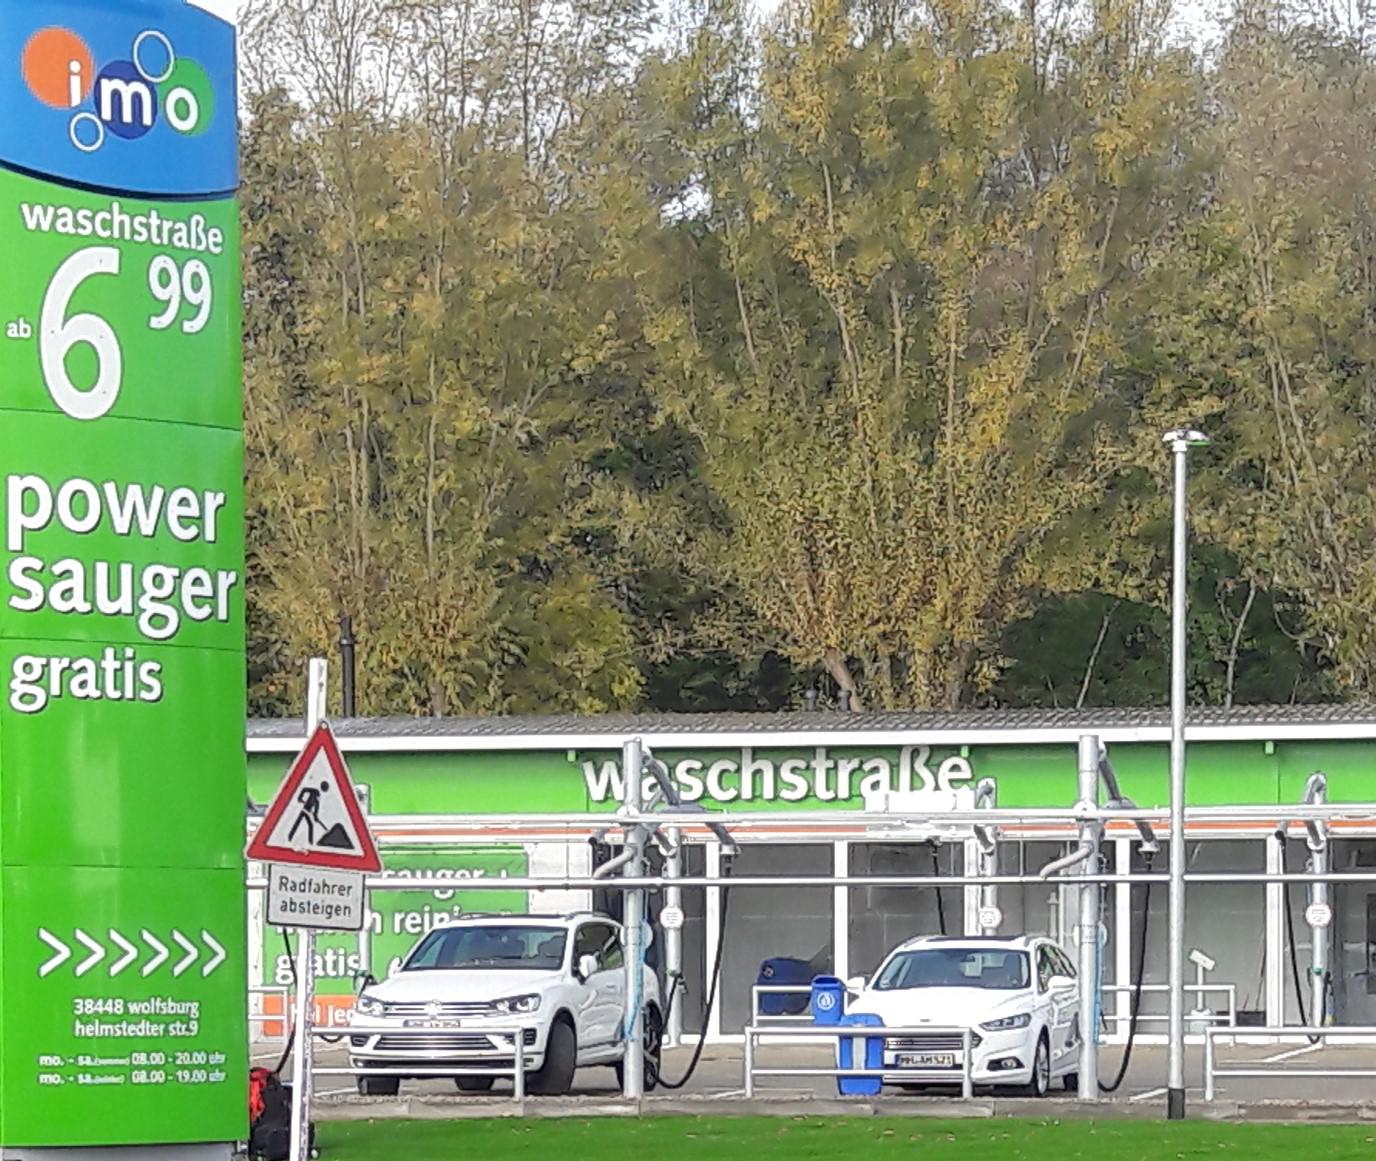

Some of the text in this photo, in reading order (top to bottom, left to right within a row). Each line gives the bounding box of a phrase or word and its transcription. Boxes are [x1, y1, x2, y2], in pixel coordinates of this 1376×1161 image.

[69, 60, 199, 132] imo
[21, 202, 224, 255] waschstraße
[6, 246, 213, 420] ab 6 99
[7, 473, 226, 552] power
[8, 556, 237, 640] sauger
[10, 647, 164, 713] gratis
[582, 745, 972, 802] waschstraße
[278, 876, 353, 897] Radfahrer
[280, 898, 352, 918] absteigen
[275, 948, 361, 985] gatis
[73, 996, 200, 1019] 38448 wolfsburg
[75, 1019, 165, 1037] helmstedter
